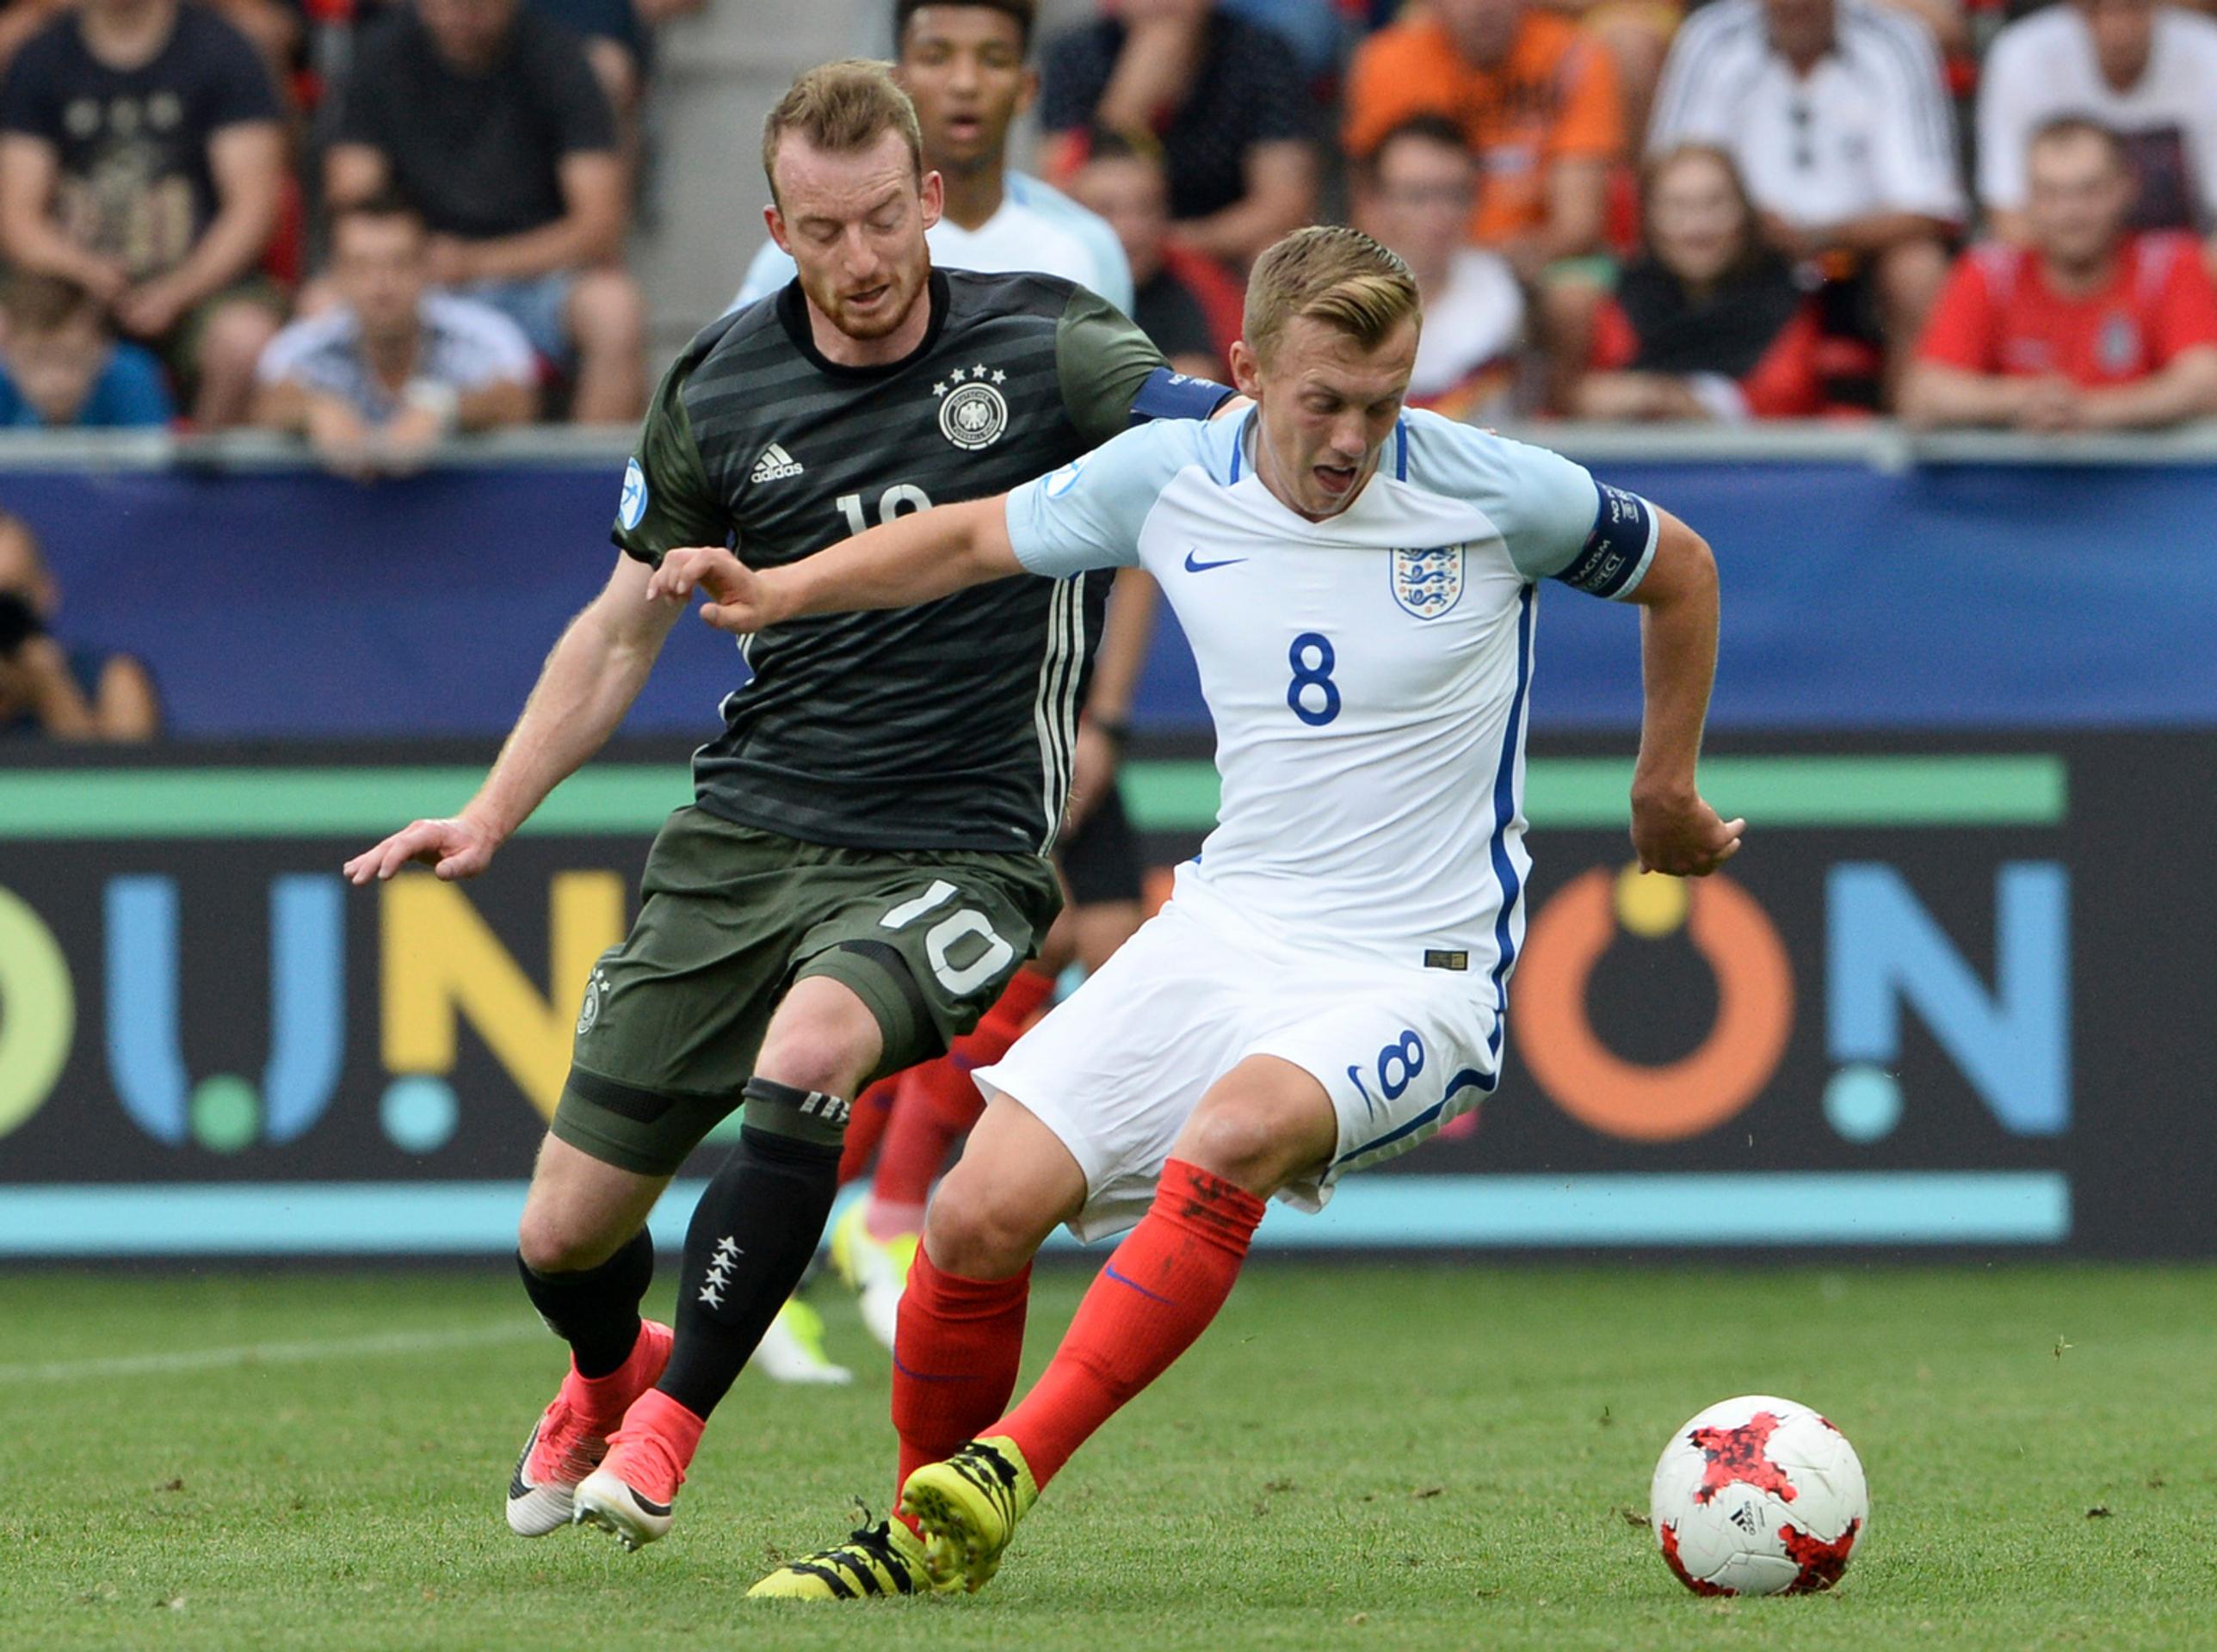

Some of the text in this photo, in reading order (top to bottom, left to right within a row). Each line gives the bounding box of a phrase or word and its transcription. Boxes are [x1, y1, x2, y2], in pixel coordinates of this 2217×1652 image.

[750, 463, 804, 483] adidas
[1288, 632, 1341, 726] 8
[880, 879, 1014, 996] 10
[1378, 1029, 1425, 1100] 8
